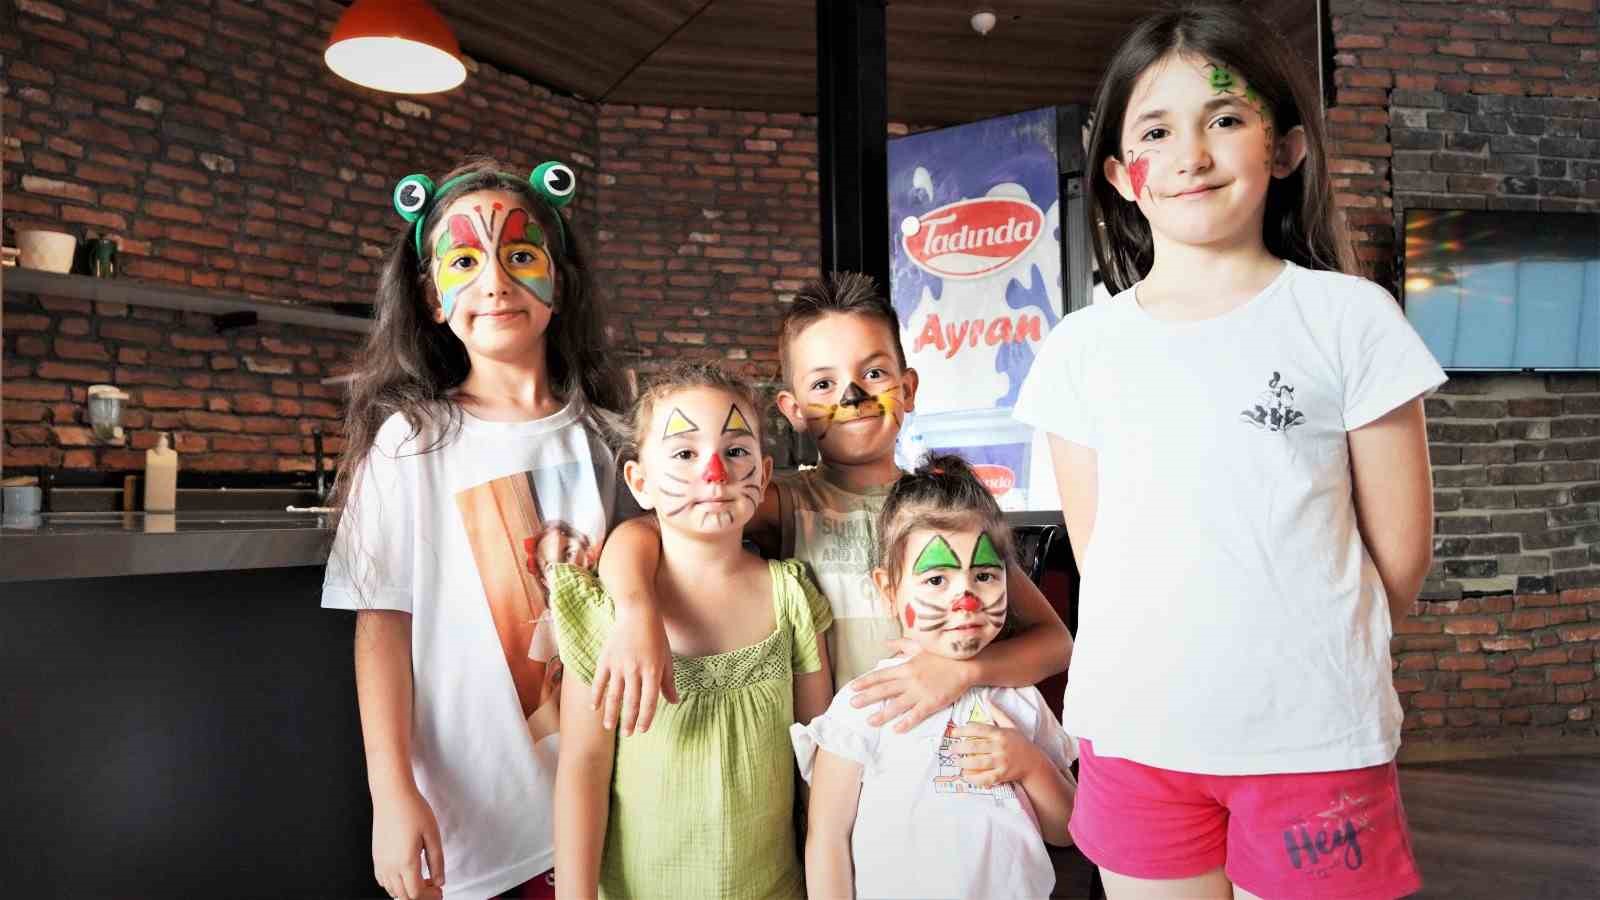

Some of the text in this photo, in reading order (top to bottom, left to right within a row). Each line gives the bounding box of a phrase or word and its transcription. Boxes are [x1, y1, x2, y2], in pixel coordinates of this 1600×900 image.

[919, 213, 1034, 256] Tadında
[912, 312, 1042, 359] Ayran
[1283, 818, 1363, 871] Hey
